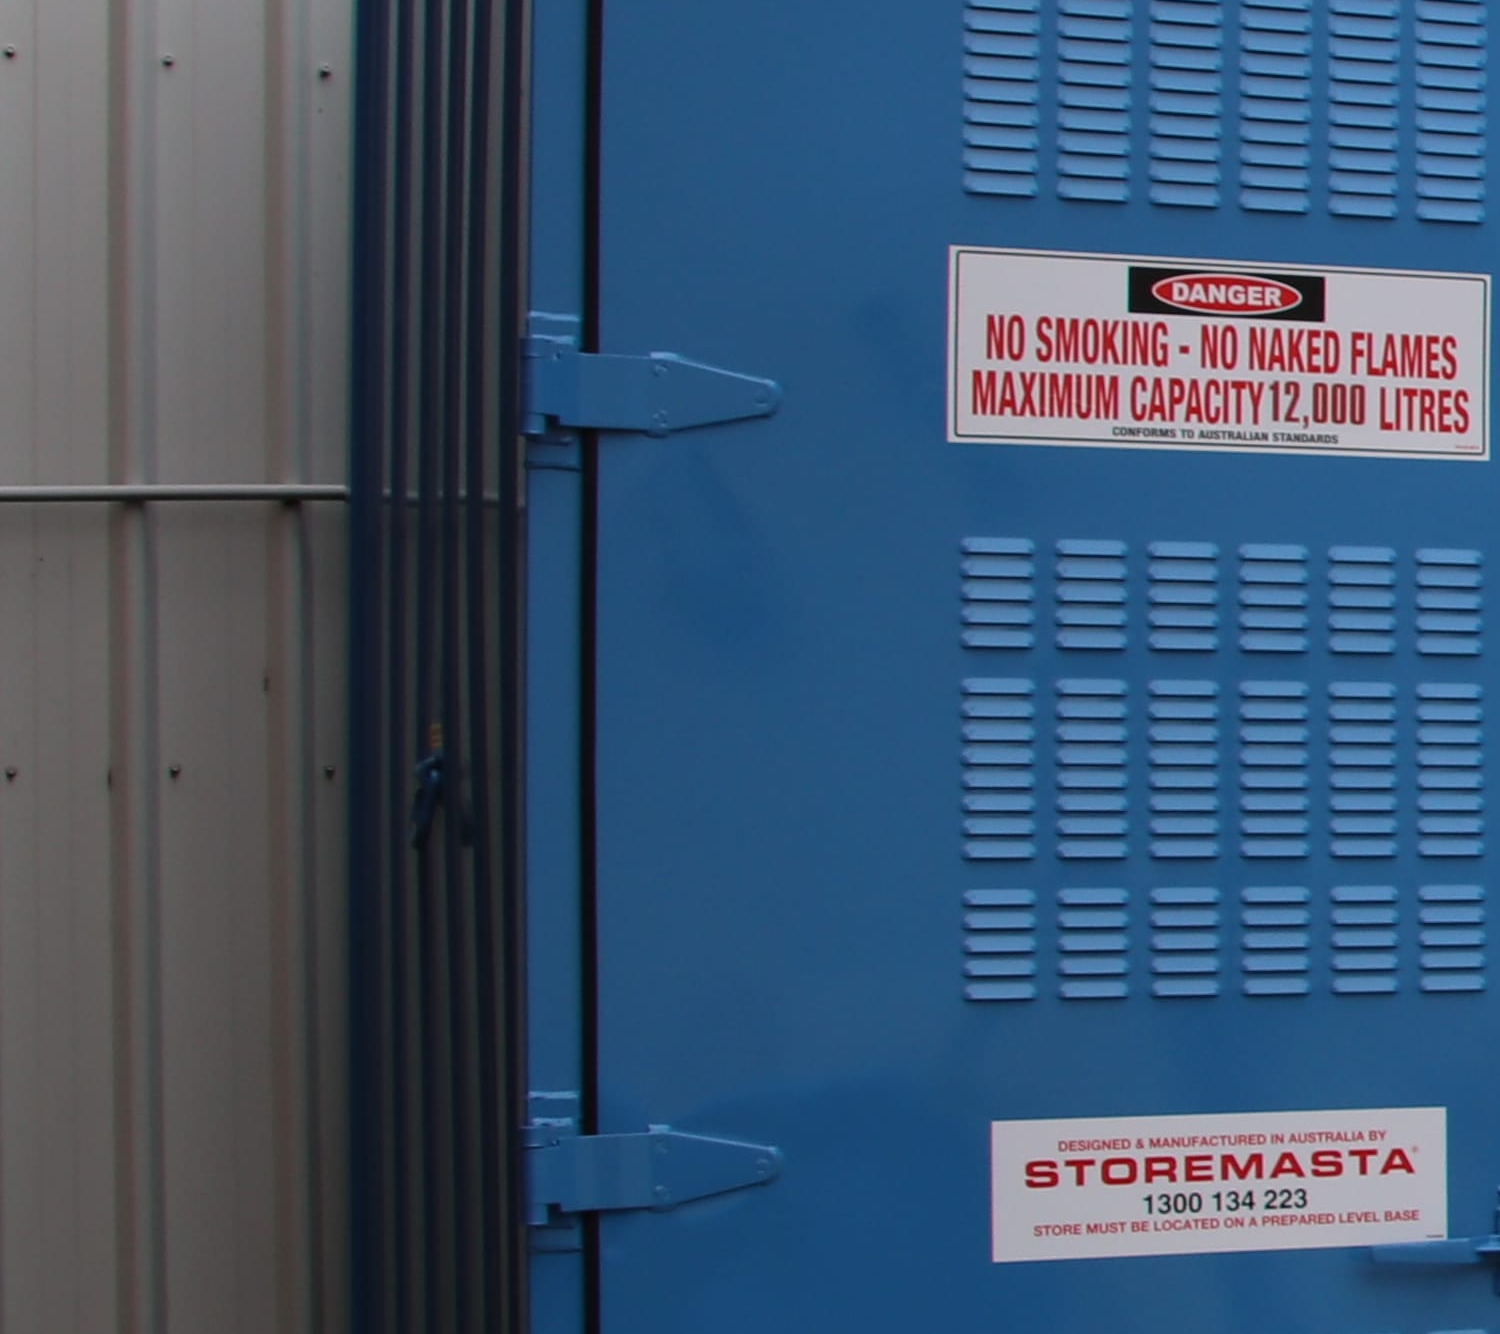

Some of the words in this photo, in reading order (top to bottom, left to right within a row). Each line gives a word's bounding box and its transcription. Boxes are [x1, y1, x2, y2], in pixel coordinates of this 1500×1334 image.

[1172, 282, 1282, 307] DANGER
[987, 315, 1024, 361] NO
[1036, 317, 1168, 366] SMOKING
[1200, 325, 1238, 370] NO
[1249, 328, 1340, 375] NAKED
[1351, 332, 1457, 380] FLAMES
[972, 371, 1119, 420] MAXIMUM
[1130, 376, 1261, 425] CAPACITY
[1269, 383, 1364, 428] 12,000
[1379, 388, 1468, 434] LITRES
[1112, 426, 1176, 439] CONFORMS
[1181, 430, 1195, 439] TO
[1198, 430, 1269, 442] AUSTRALIAN
[1273, 433, 1338, 444] STANDARDS
[1058, 1139, 1131, 1152] DESIGNED
[1136, 1139, 1144, 1149] &
[1149, 1134, 1266, 1149] MANUFACTURED
[1271, 1133, 1284, 1144] IN
[1288, 1131, 1364, 1143] AUSTRALIA
[1369, 1130, 1386, 1141] BY
[1144, 1193, 1201, 1214] 1300
[1212, 1191, 1255, 1212] 134
[1264, 1189, 1308, 1210] 223
[1034, 1225, 1081, 1237] STORE
[1086, 1222, 1127, 1234] MUST
[1131, 1221, 1149, 1232] BE
[1154, 1218, 1219, 1231] LOCATED
[1224, 1218, 1244, 1228] ON
[1248, 1217, 1257, 1226] A
[1262, 1213, 1335, 1227] PREPARED
[1339, 1212, 1380, 1223] LEVEL
[1384, 1210, 1419, 1222] BASE
